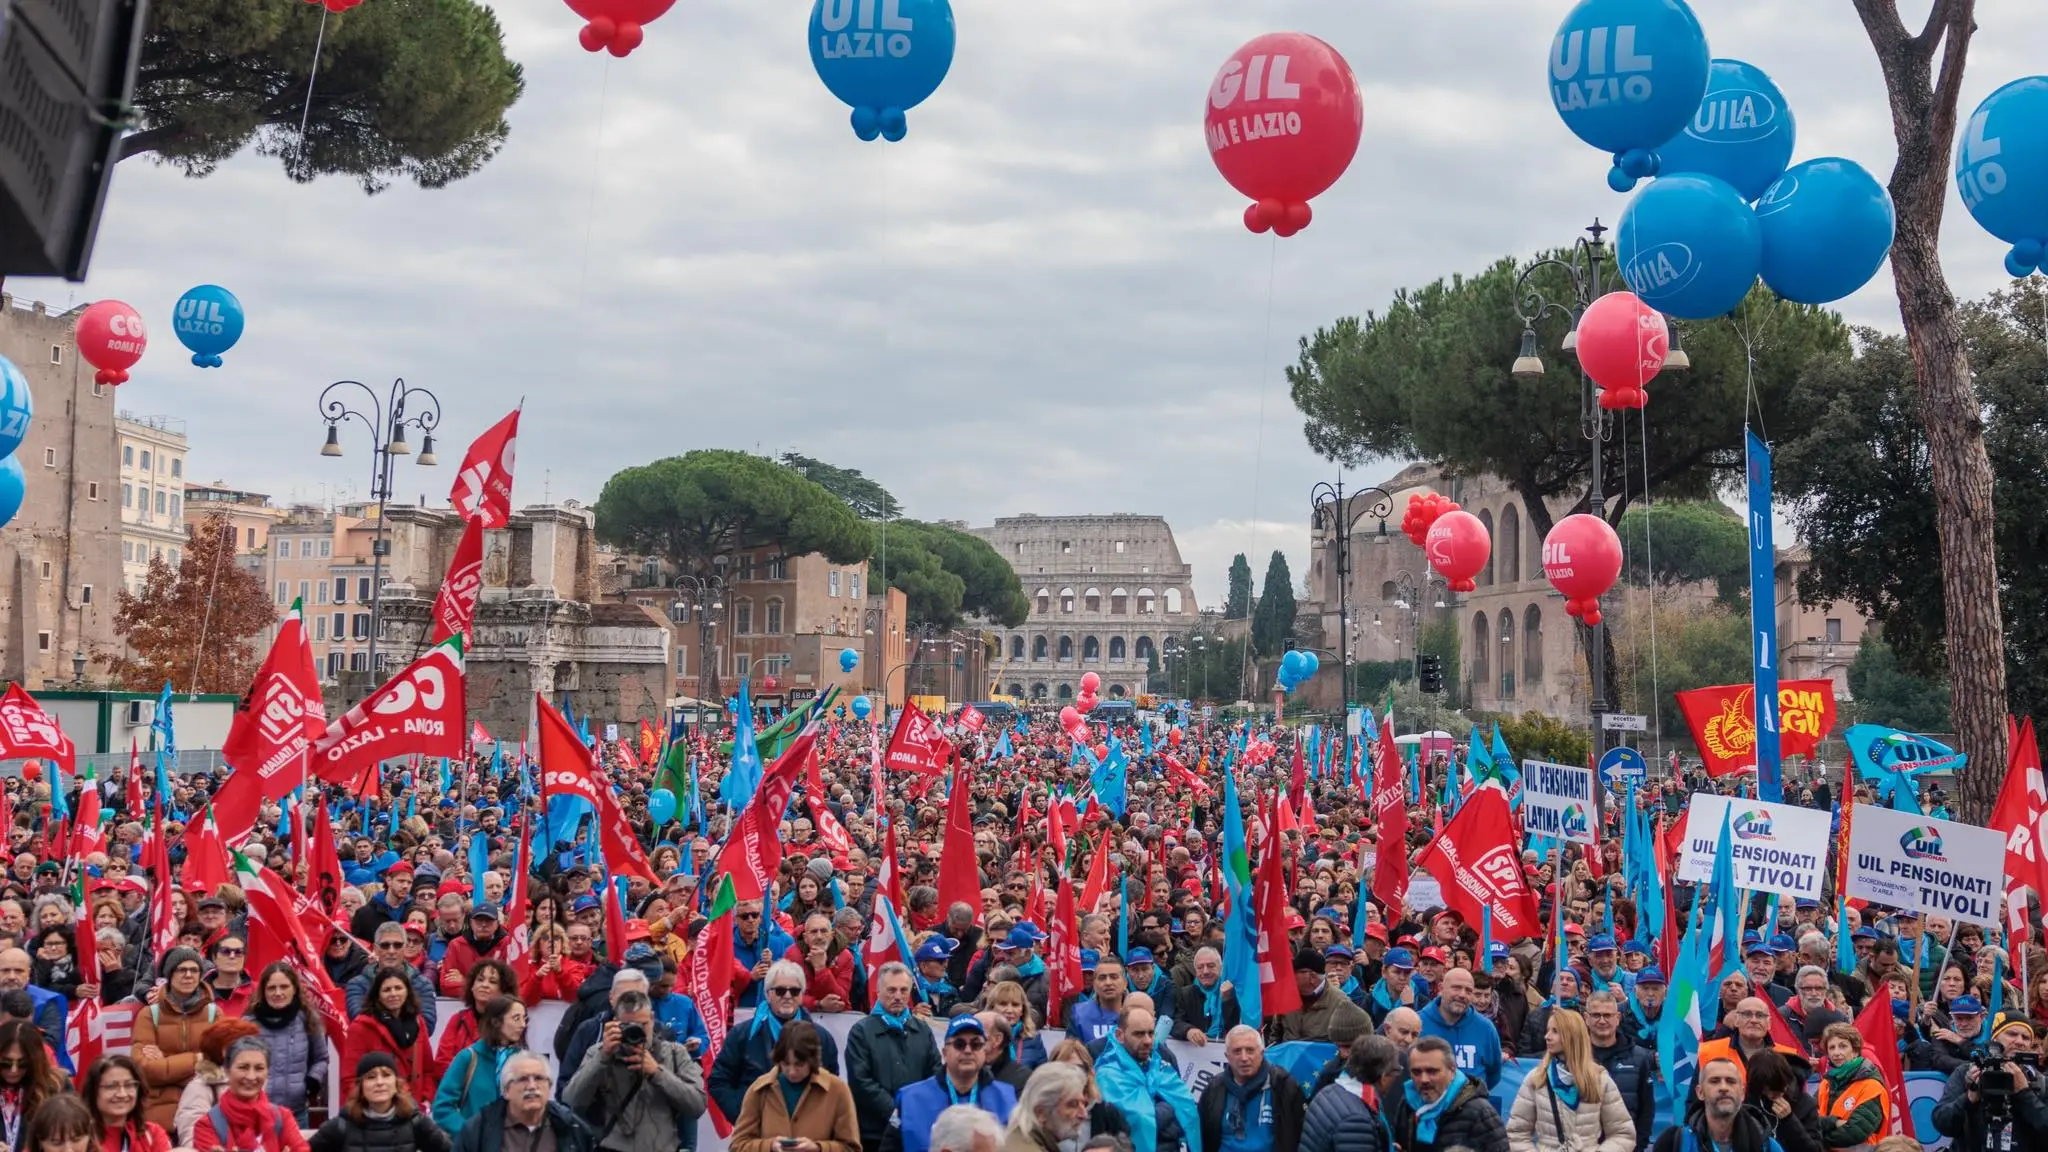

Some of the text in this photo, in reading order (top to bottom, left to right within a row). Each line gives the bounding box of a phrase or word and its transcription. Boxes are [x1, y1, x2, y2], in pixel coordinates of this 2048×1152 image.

[821, 0, 913, 31] UIL
[821, 33, 912, 58] LAZIO
[1552, 25, 1652, 81] UIL
[1210, 55, 1300, 109] GIL
[1553, 75, 1651, 112] LAZIO
[1694, 95, 1757, 133] UILA
[1206, 111, 1301, 152] MA E LAZIO
[1957, 161, 2007, 213] ZIO
[1628, 251, 1679, 294] UILA
[178, 299, 225, 322] UIL
[110, 314, 147, 337] CG
[178, 321, 223, 335] LAZIO
[107, 339, 135, 352] ROMA
[1542, 543, 1570, 565] GIL
[795, 691, 812, 699] BAR
[1779, 688, 1824, 714] OM
[2, 706, 32, 743] CGIL
[891, 751, 917, 764] ROMA
[1890, 755, 1957, 772] PENSIONATI
[1525, 764, 1538, 792] UIL
[1540, 766, 1588, 800] PENSIONATI
[1526, 805, 1559, 833] LATINA
[1571, 817, 1587, 832] UIL
[1747, 822, 1771, 836] UIL
[1692, 839, 1816, 870] UIL ENSIONATI
[1915, 839, 1942, 856] UIL
[1484, 856, 1520, 891] SPI
[1748, 865, 1813, 892] TIVOLI
[1857, 875, 1907, 892] COORDINAMENTO
[1858, 854, 1991, 896] UIL PENSIONATI
[1919, 886, 1990, 919] TIVOLI
